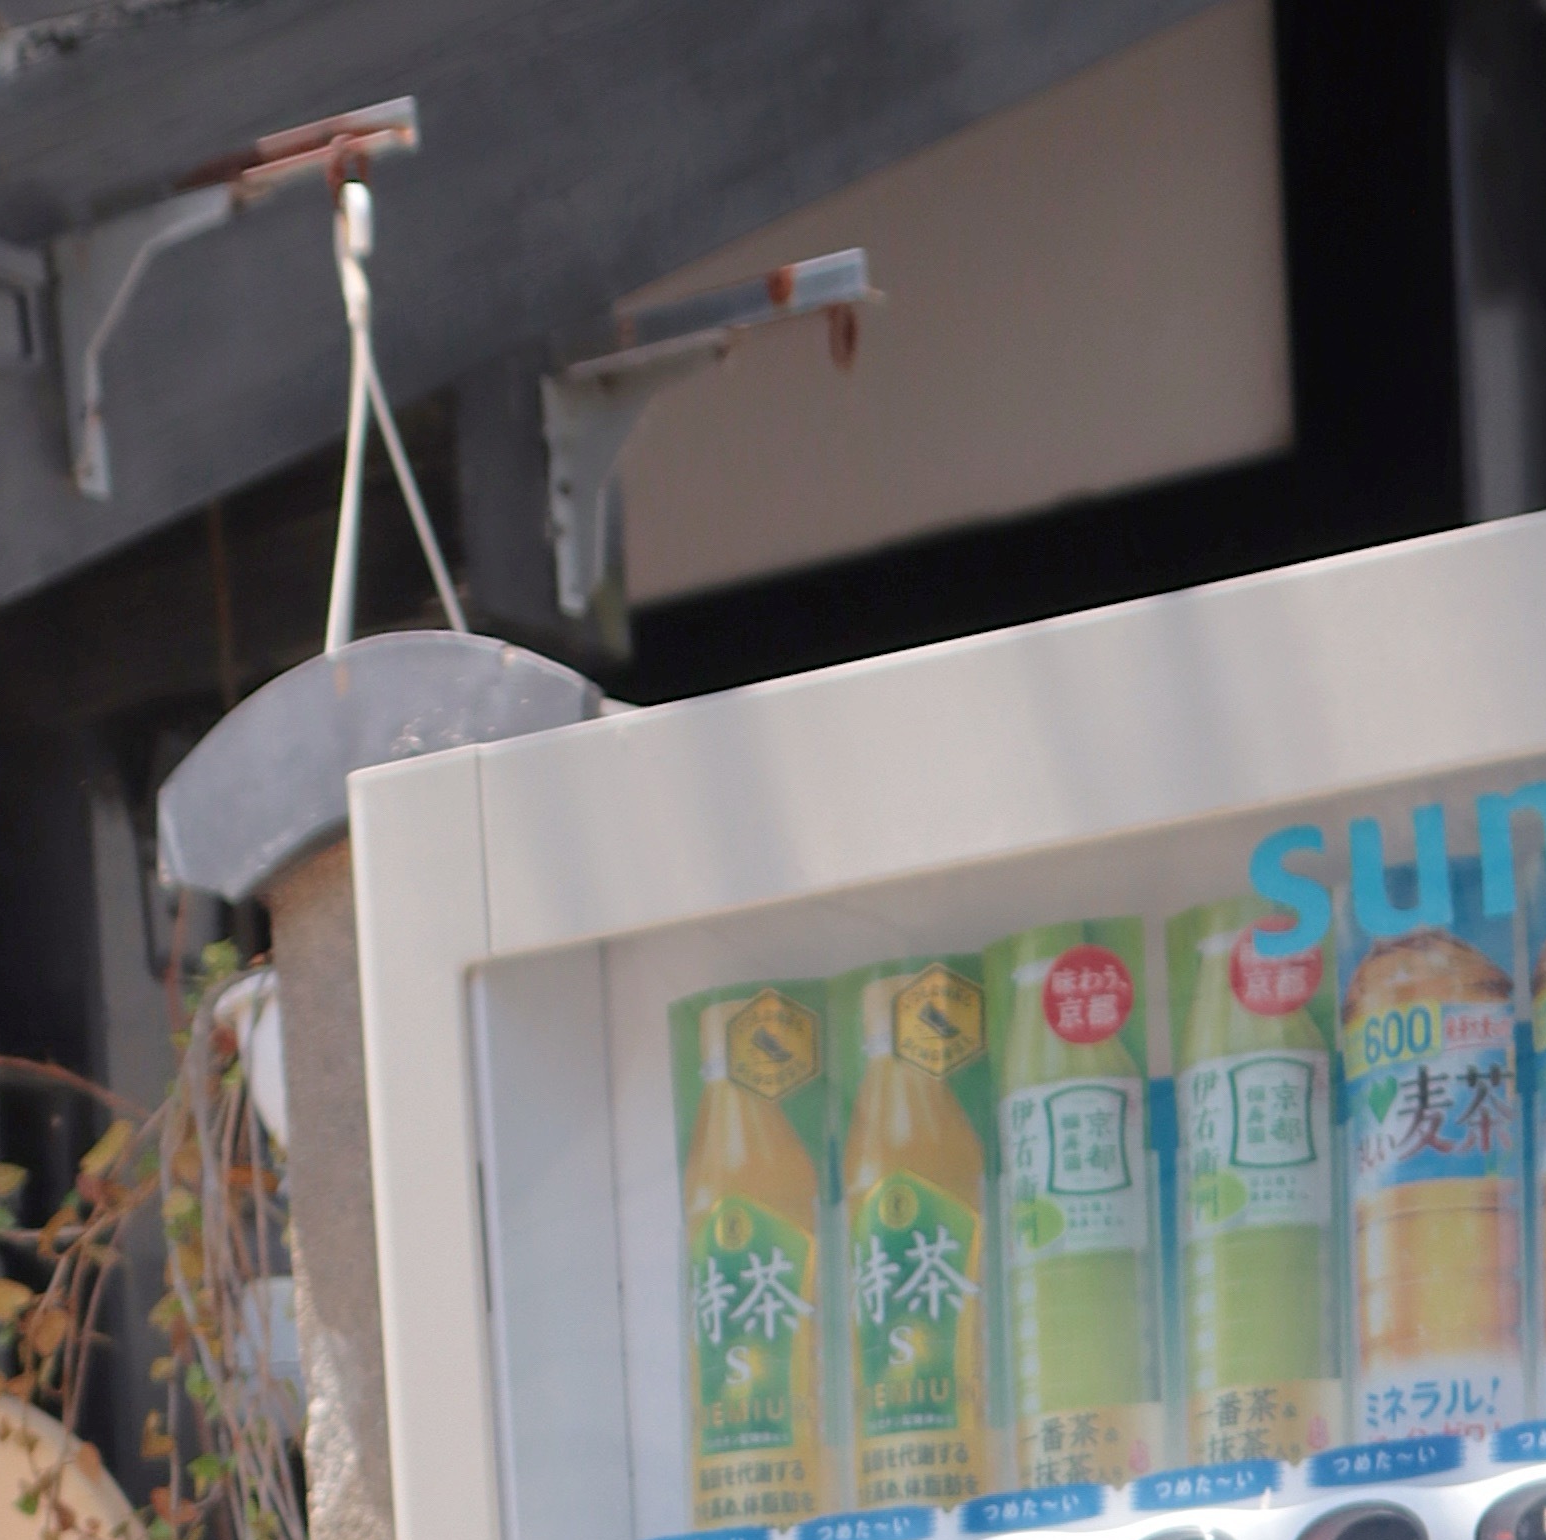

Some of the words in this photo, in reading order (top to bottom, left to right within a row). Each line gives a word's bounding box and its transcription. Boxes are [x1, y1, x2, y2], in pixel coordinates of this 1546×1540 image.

[1364, 1005, 1433, 1065] 600
[1398, 1064, 1514, 1160] 麦茶
[725, 1346, 752, 1385] S
[889, 1326, 915, 1364] S
[1365, 1376, 1501, 1428] ミネラル!
